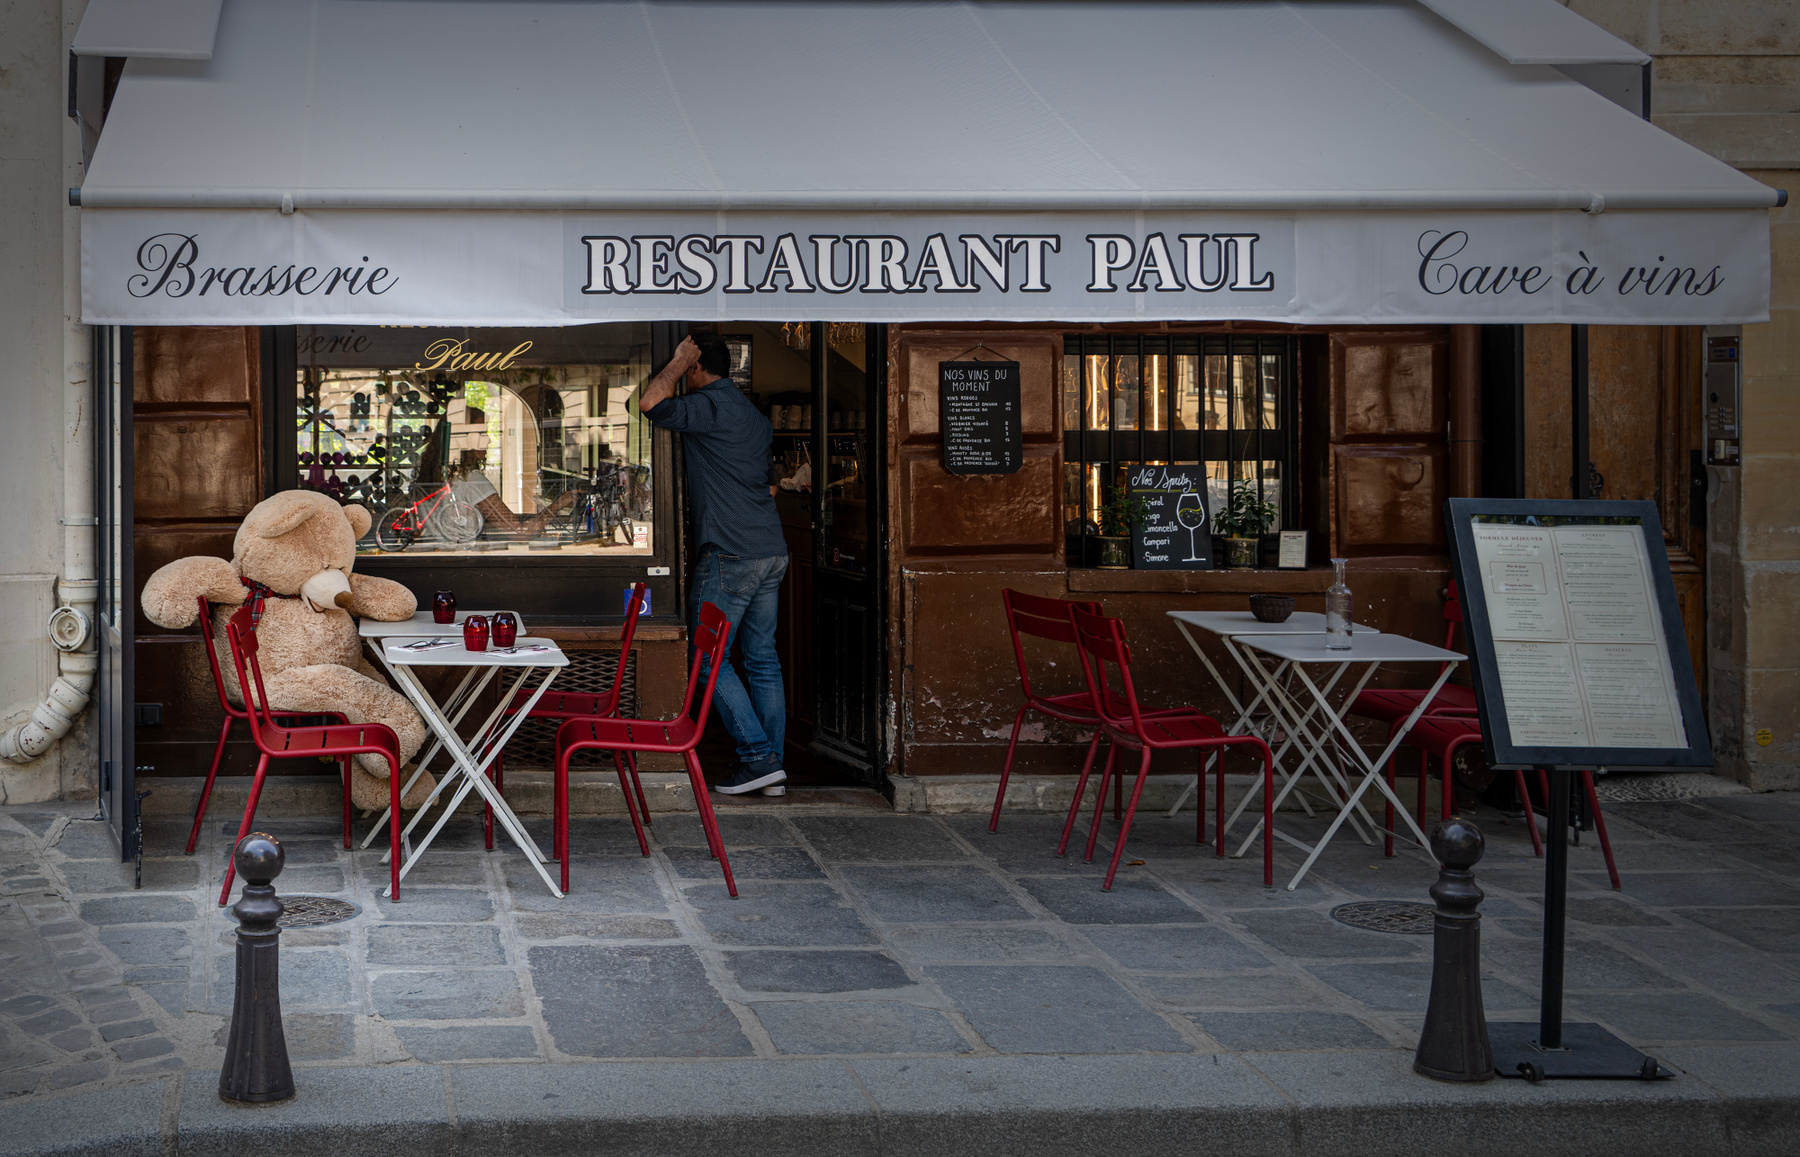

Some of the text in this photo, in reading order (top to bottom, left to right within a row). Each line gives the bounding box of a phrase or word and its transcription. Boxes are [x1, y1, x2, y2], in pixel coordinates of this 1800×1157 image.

[127, 233, 399, 298] Brasserie
[581, 232, 1274, 294] RESTAURANT PAUL
[1417, 229, 1725, 296] Cave à vins
[416, 337, 533, 371] Paul
[945, 370, 1007, 380] NOS VINS DU
[953, 382, 990, 391] MOMENT
[1132, 468, 1155, 486] Nos
[1145, 552, 1169, 562] Simone
